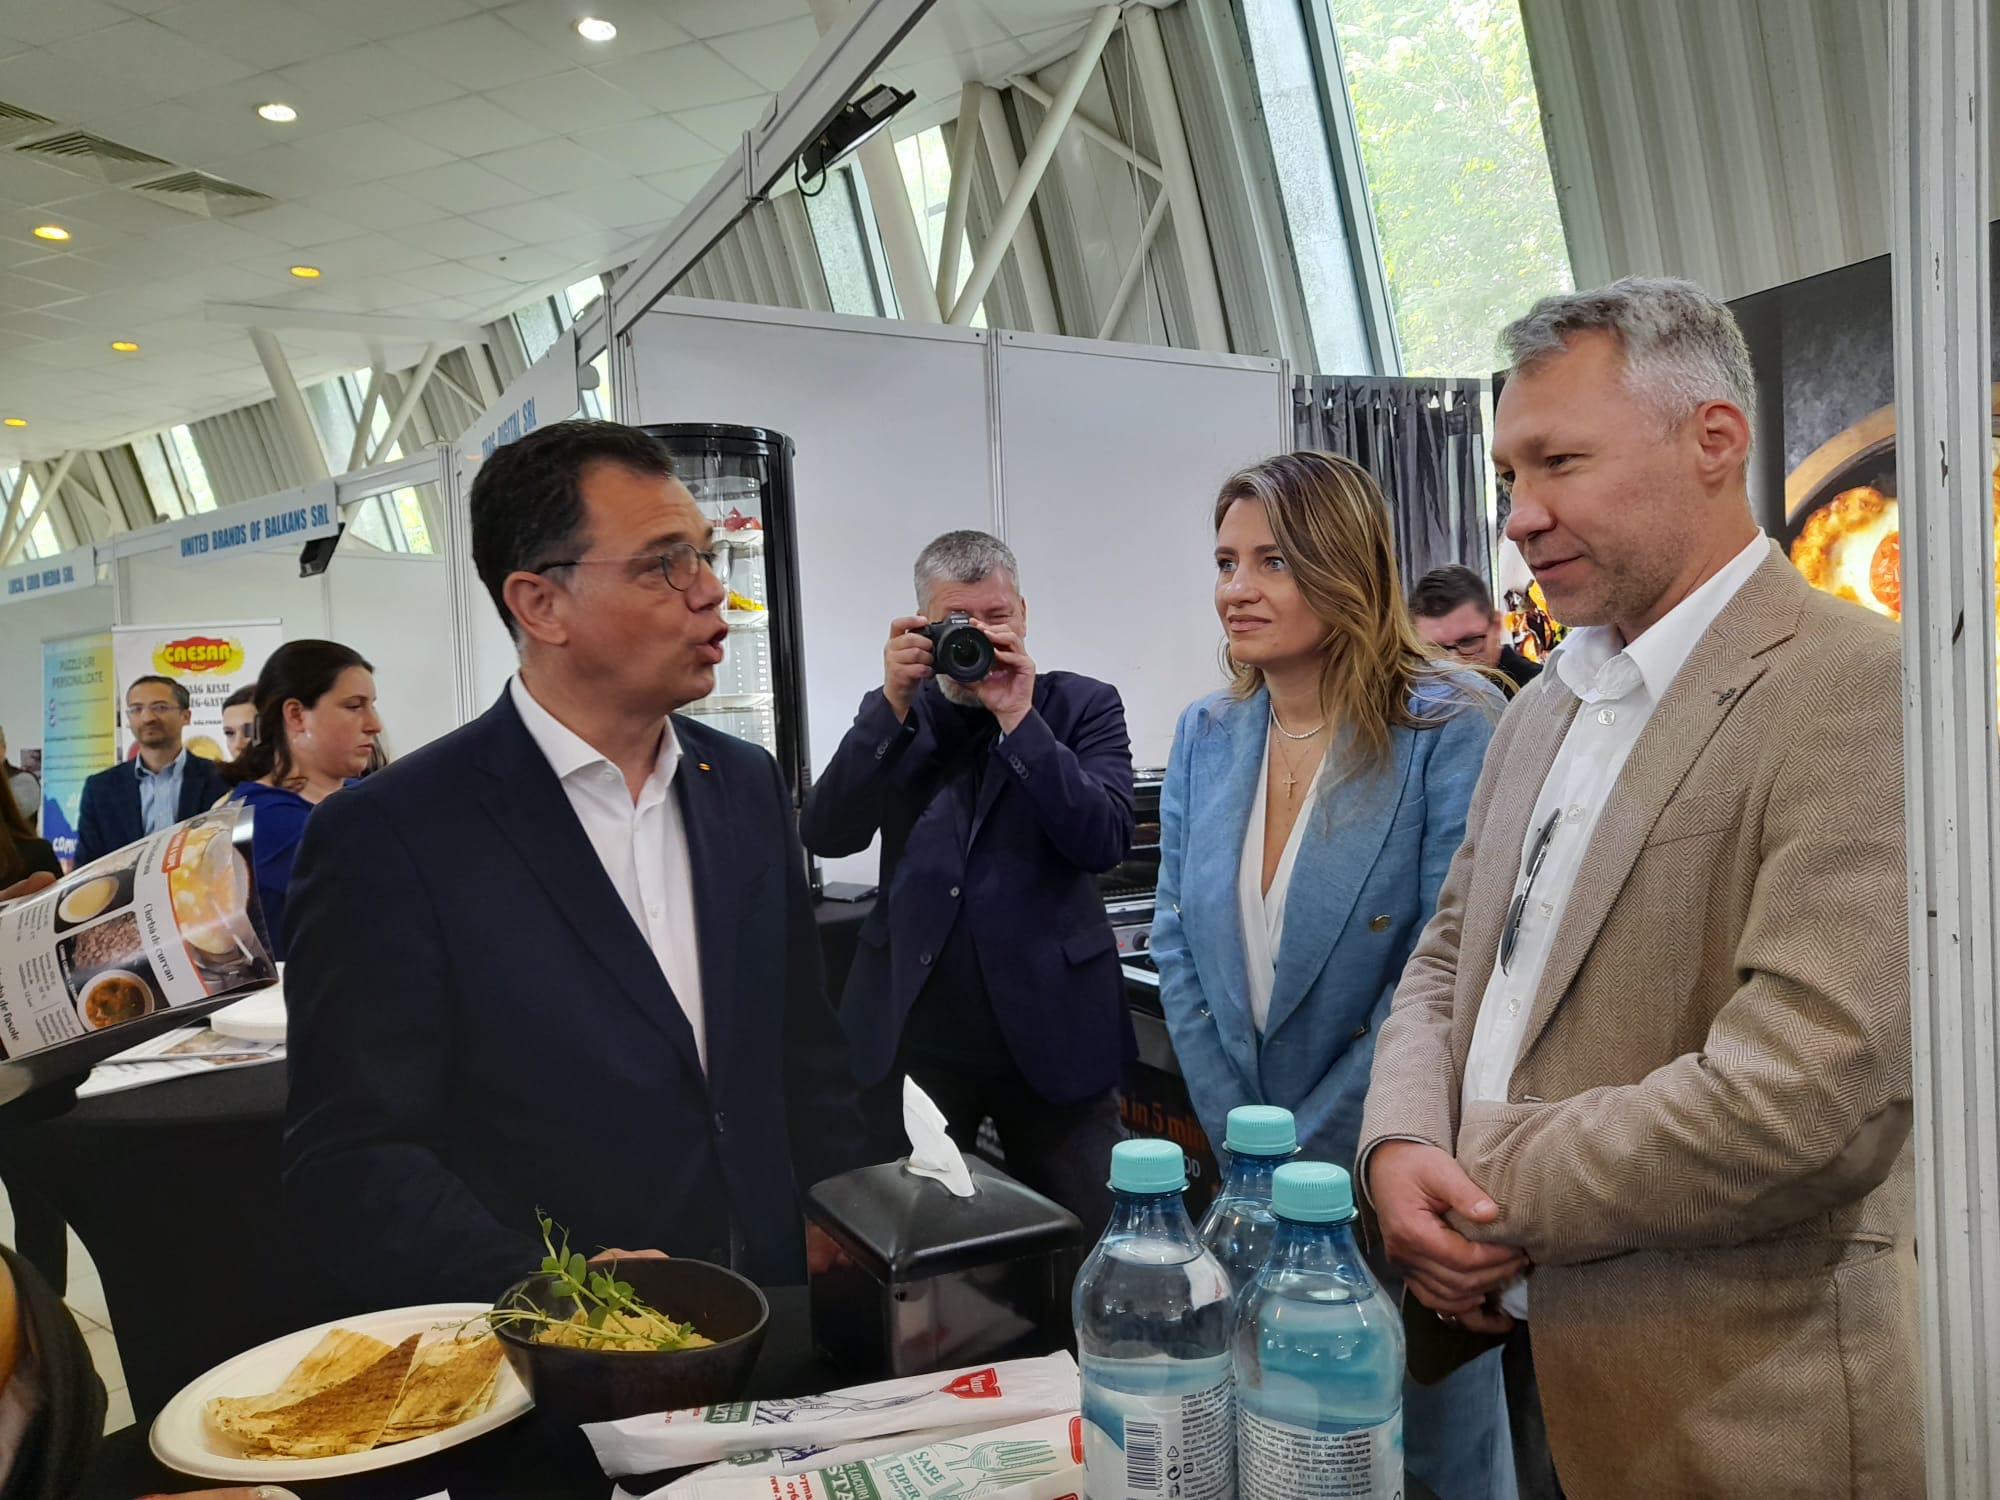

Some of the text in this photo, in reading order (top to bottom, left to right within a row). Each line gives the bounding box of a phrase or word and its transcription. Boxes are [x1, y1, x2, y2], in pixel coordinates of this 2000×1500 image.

[523, 396, 536, 432] SRL
[181, 503, 330, 557] UNITED BRANDS OF BALKANS SRL
[164, 644, 232, 662] CAESAR
[155, 947, 175, 982] curcan
[3, 1012, 19, 1041] fasole
[1152, 1103, 1165, 1134] 5
[891, 1463, 920, 1500] PIPER
[914, 1451, 946, 1483] SARE
